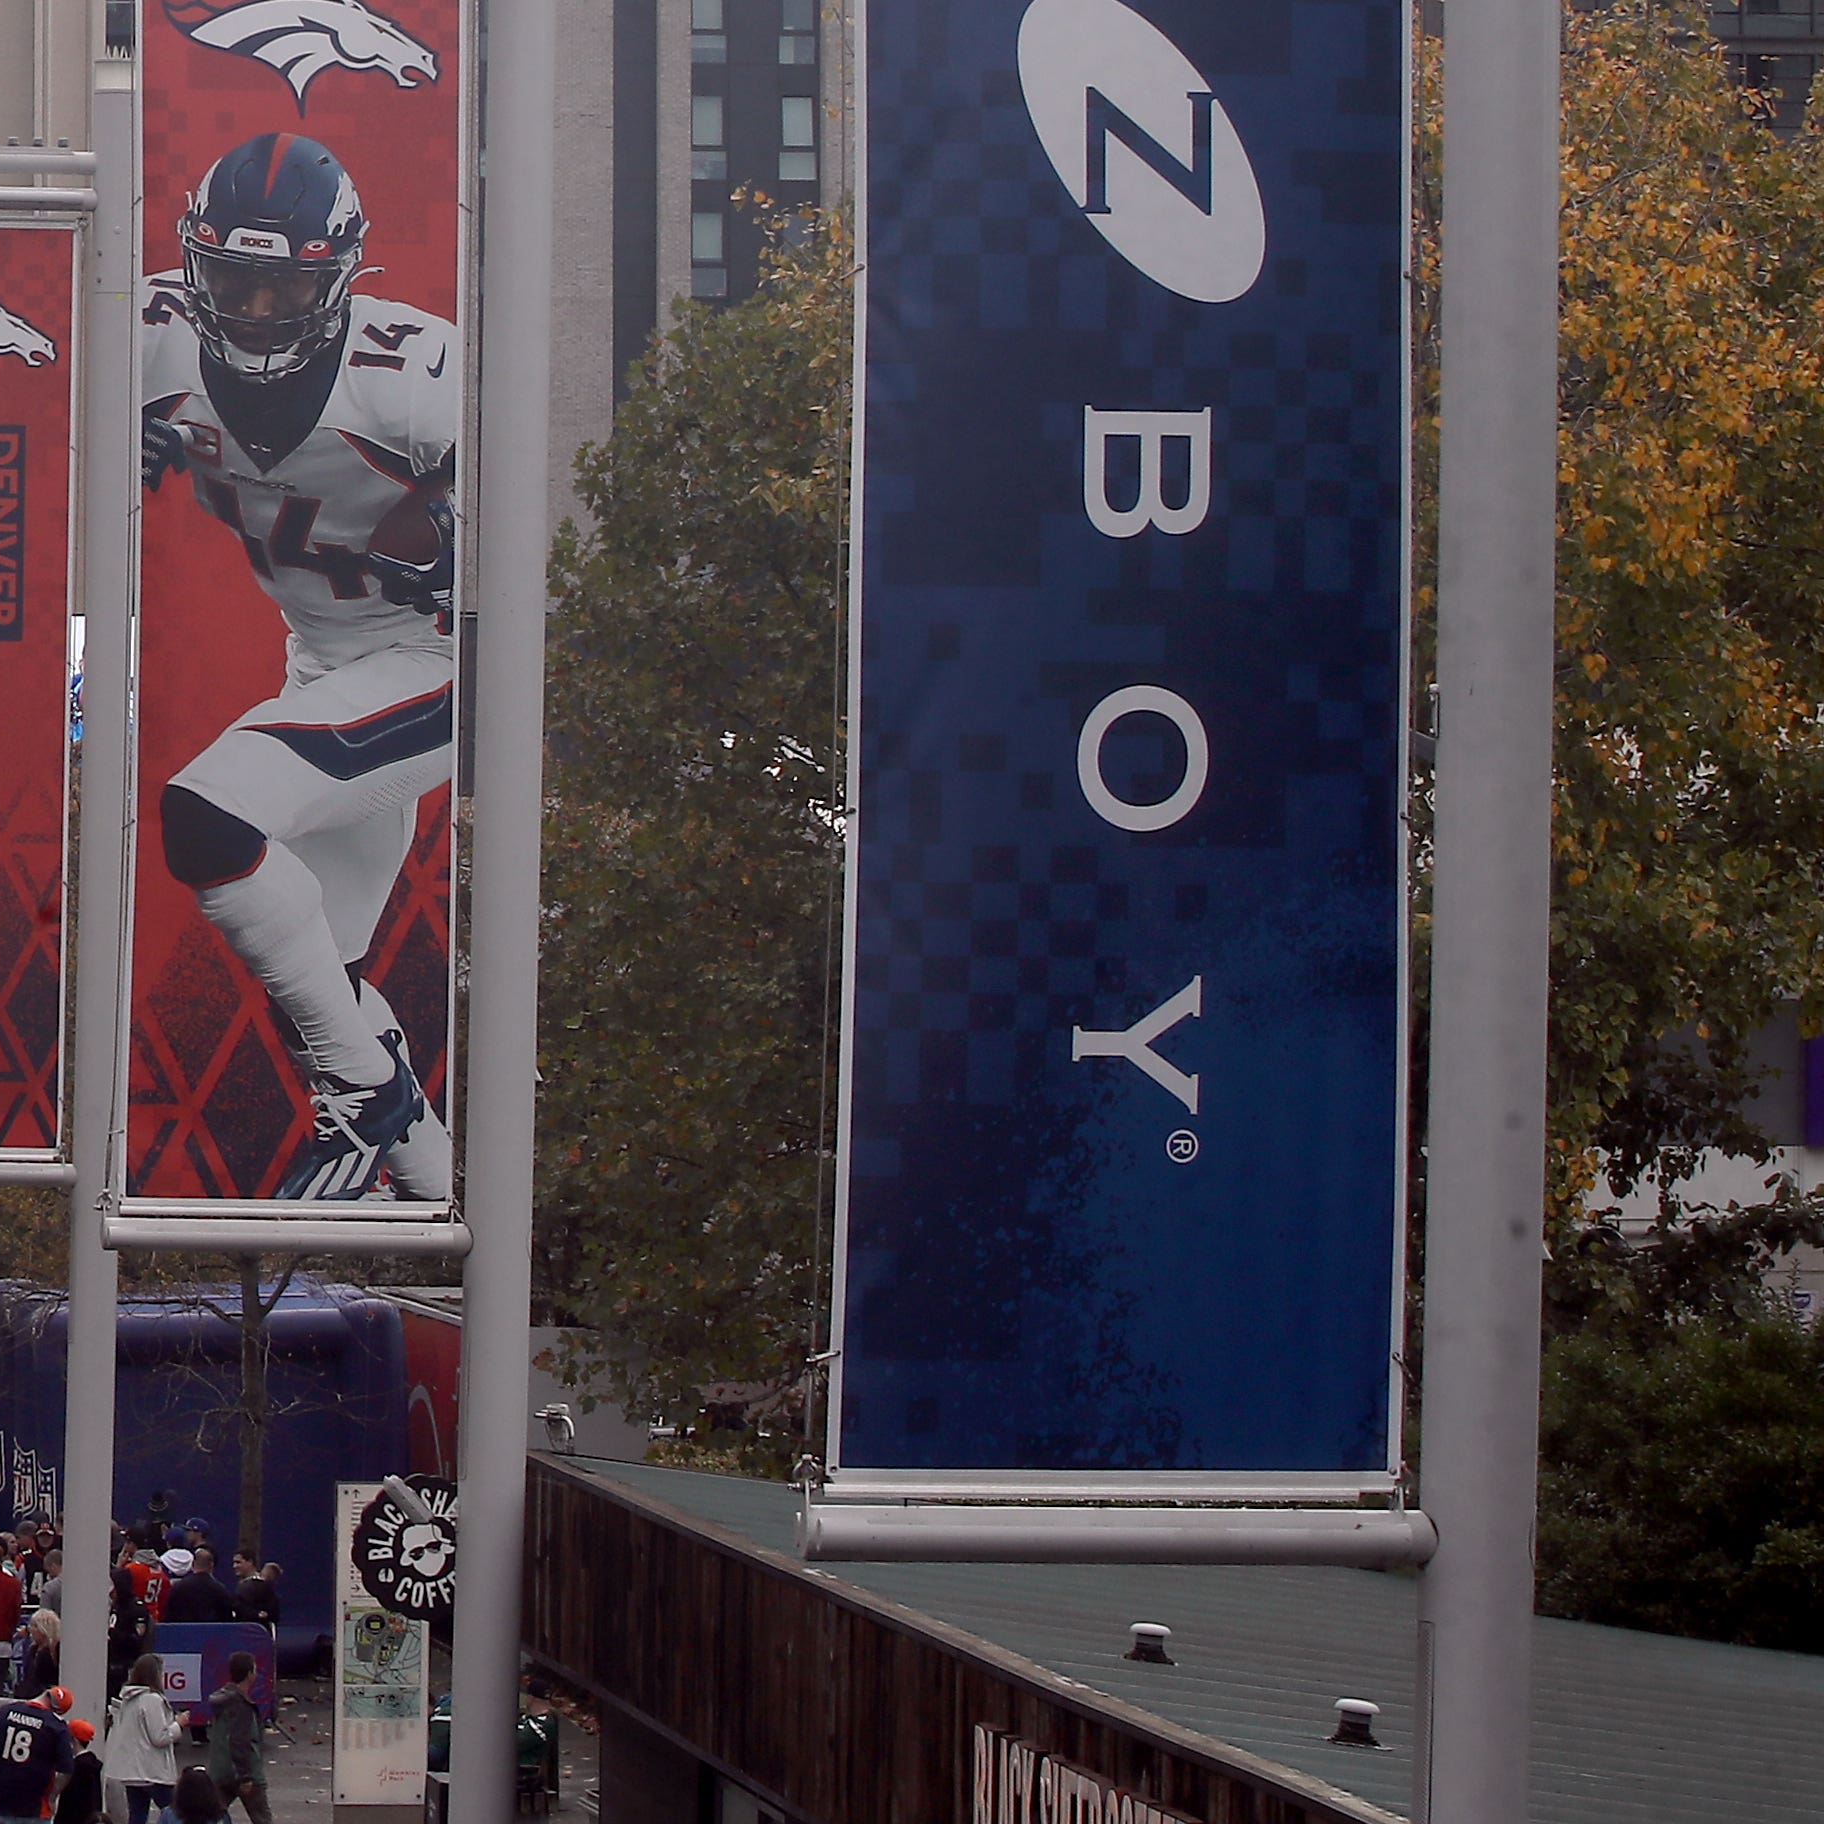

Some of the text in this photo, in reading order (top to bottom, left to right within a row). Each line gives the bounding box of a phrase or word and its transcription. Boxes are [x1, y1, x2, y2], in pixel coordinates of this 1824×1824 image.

[368, 1503, 409, 1561] BLAC
[395, 1571, 456, 1608] COFF
[2, 1725, 33, 1764] 18
